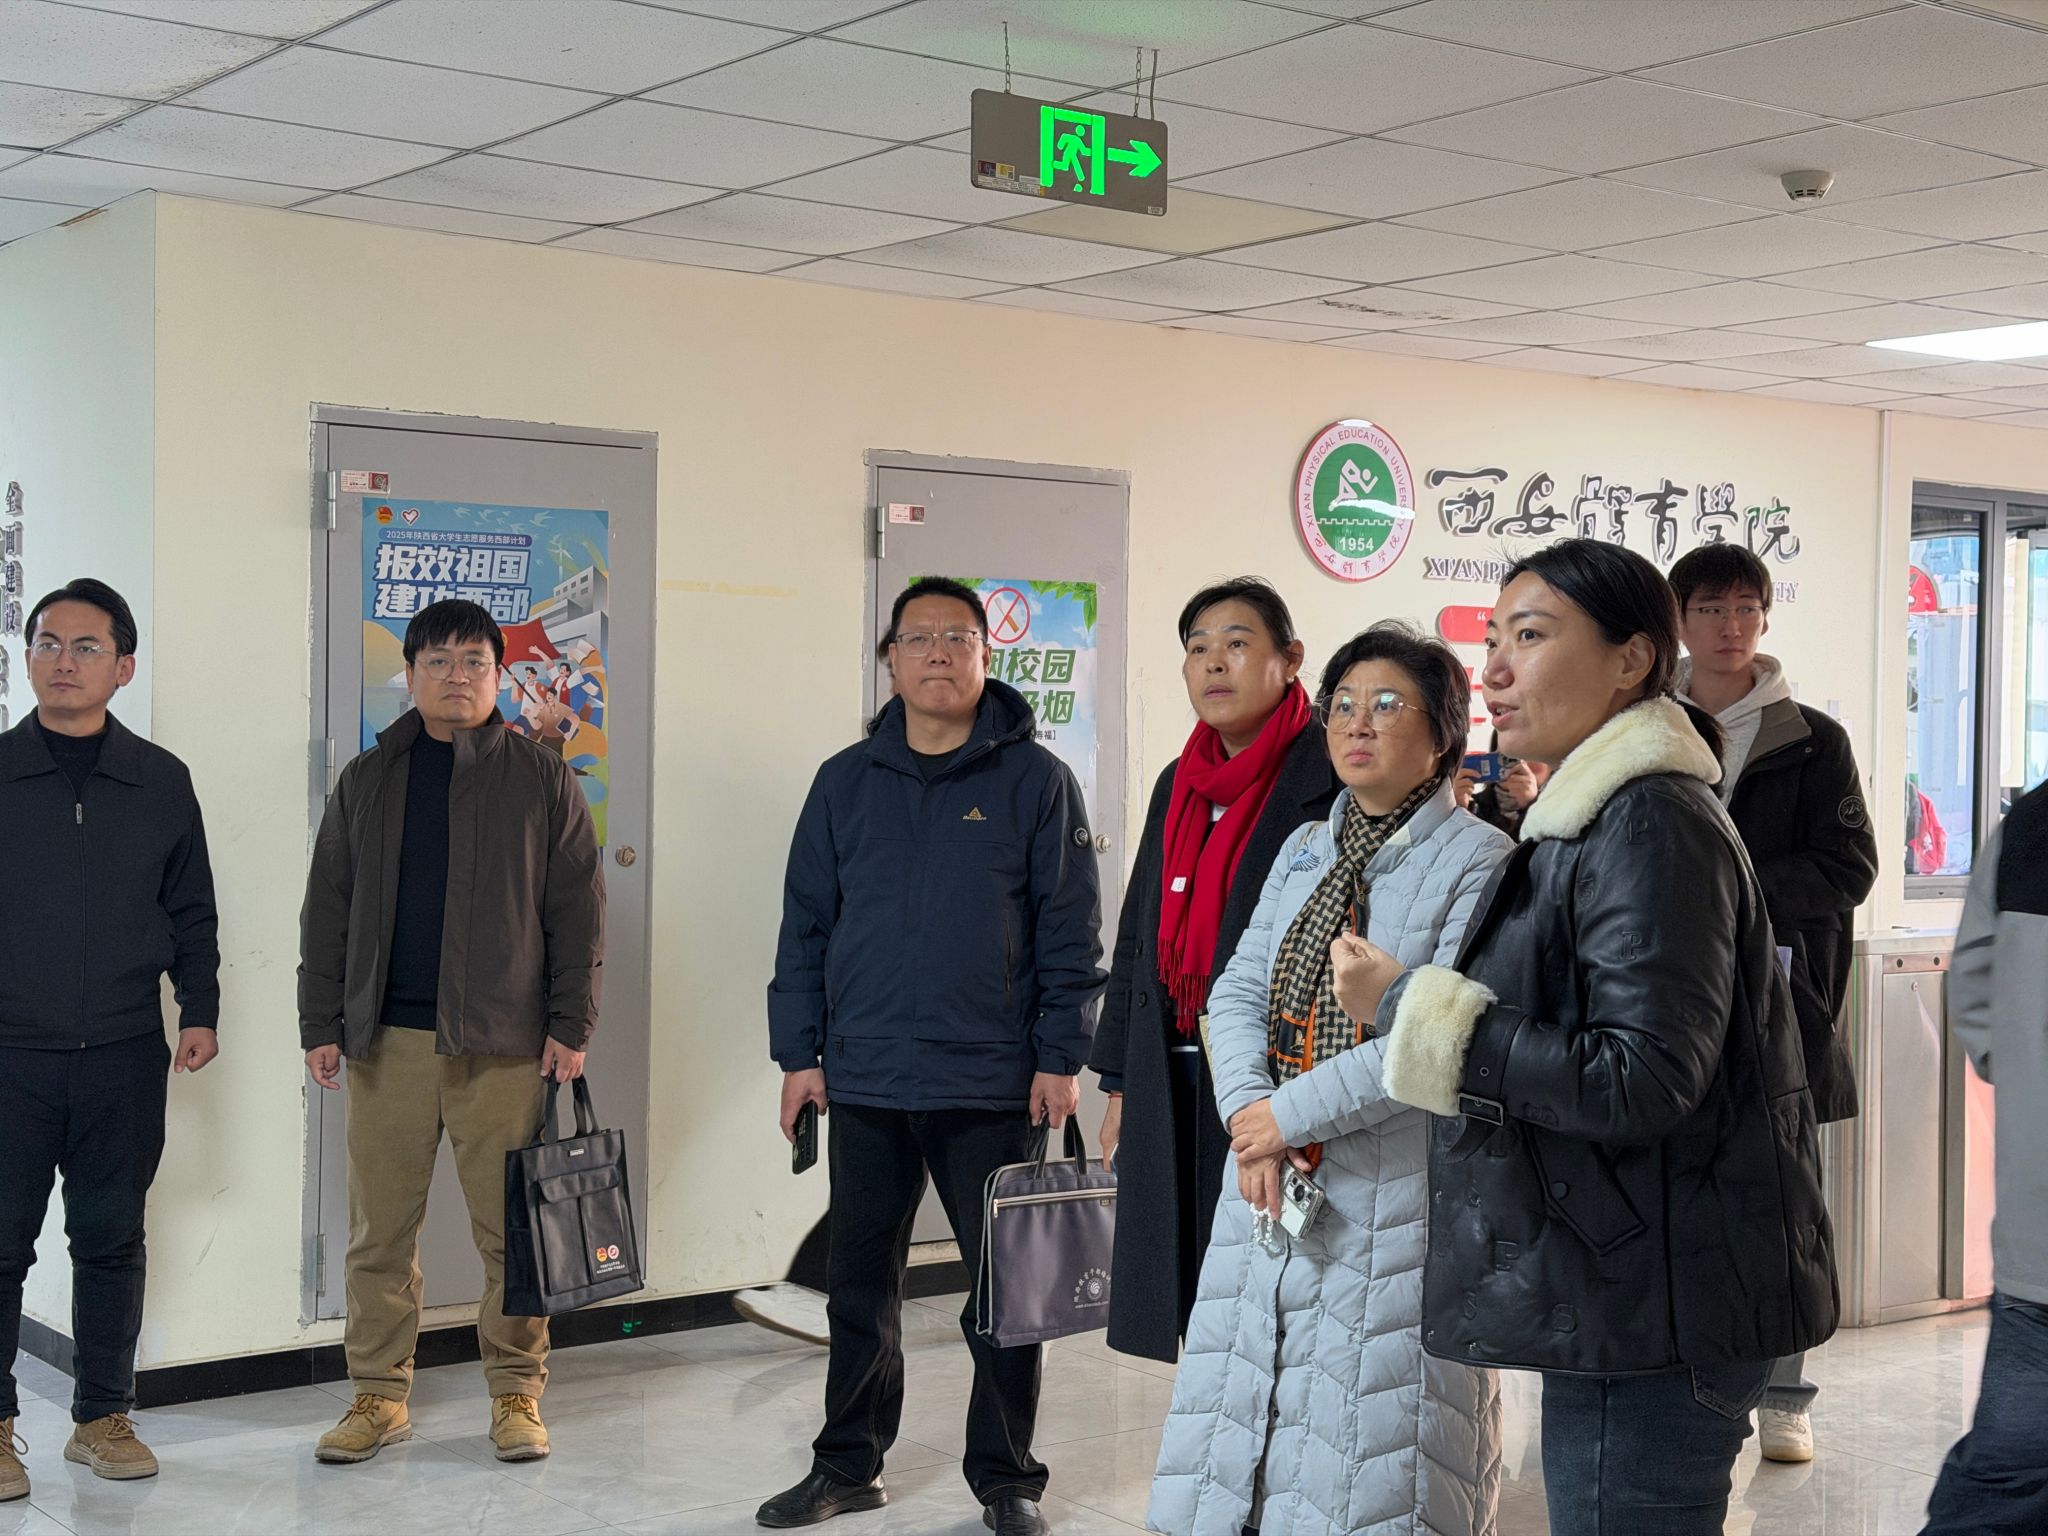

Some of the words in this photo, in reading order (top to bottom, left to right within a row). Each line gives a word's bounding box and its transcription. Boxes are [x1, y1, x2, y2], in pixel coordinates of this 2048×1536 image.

[1304, 437, 1336, 487] PHYSICAL
[1338, 428, 1390, 456] EDUCATION
[386, 530, 526, 546] 2025年陕西省大学生志愿服务西部计划
[1339, 537, 1374, 553] 1954
[375, 544, 530, 584] 报效祖国
